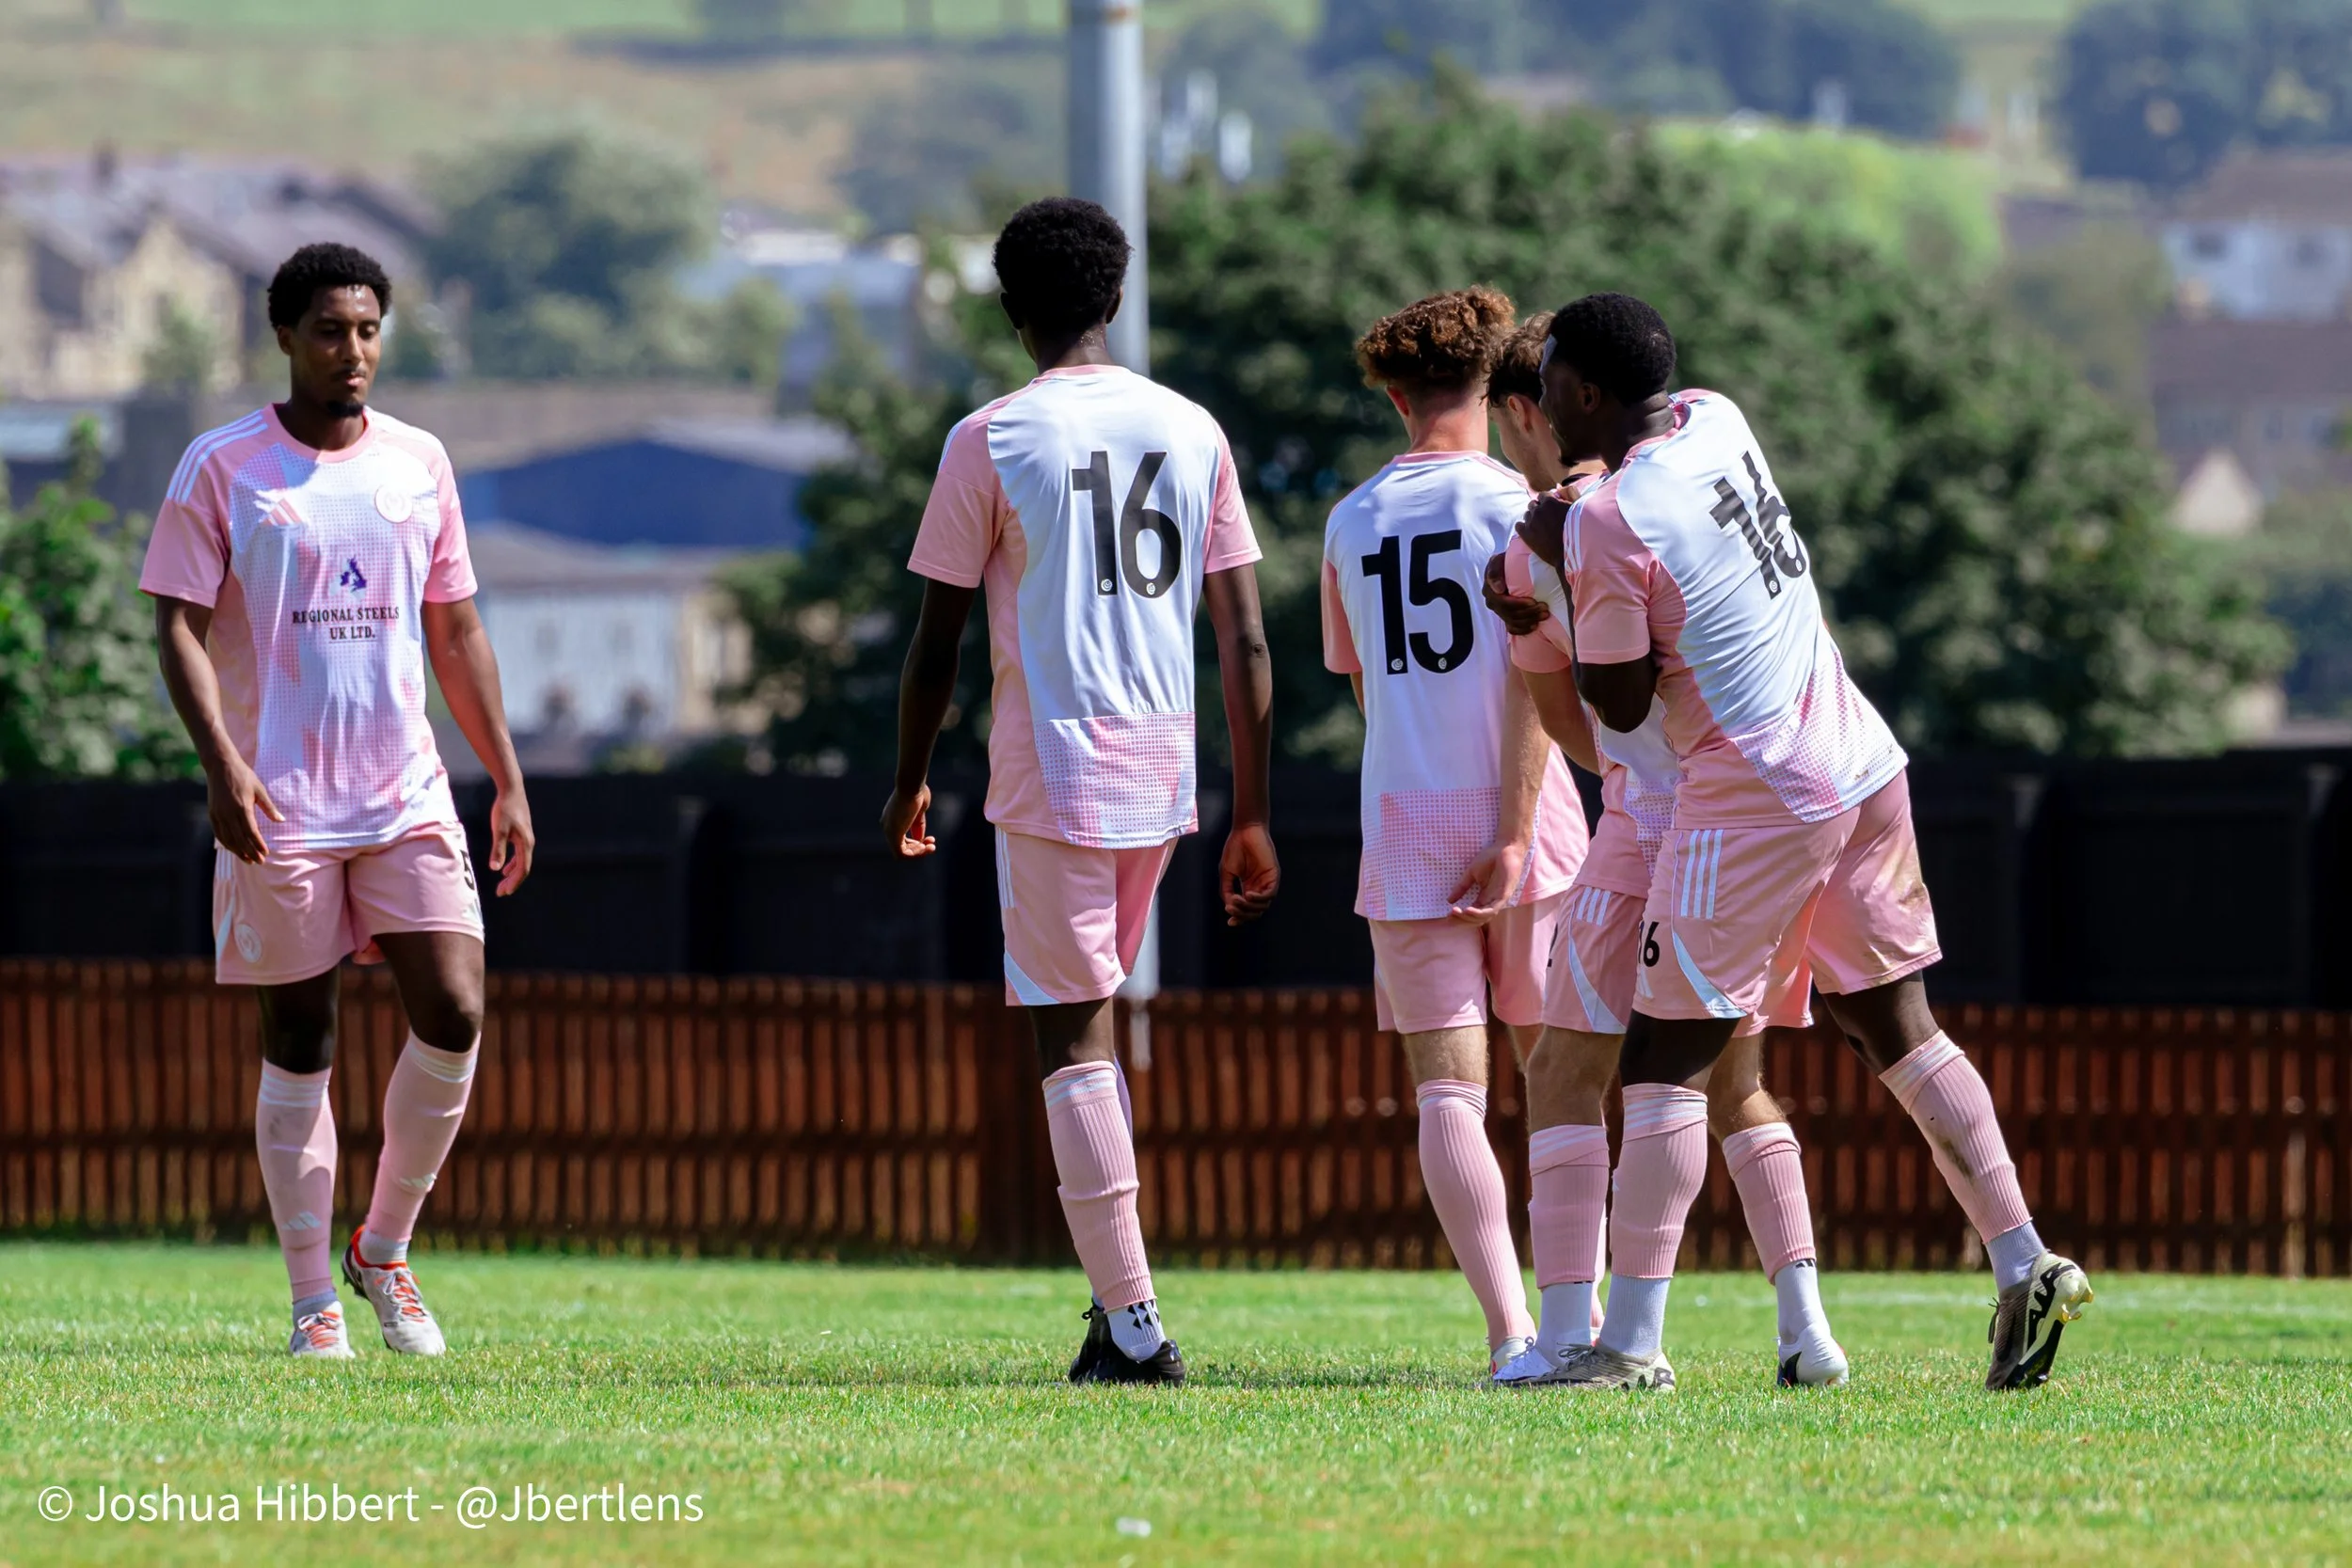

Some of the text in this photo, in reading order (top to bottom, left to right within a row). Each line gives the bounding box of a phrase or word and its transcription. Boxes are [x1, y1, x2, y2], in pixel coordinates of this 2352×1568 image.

[1071, 451, 1182, 599] 16
[1708, 451, 1807, 600] 16
[292, 607, 400, 624] REGIONAL STEELS
[329, 626, 376, 640] UK LTD.
[1360, 529, 1474, 675] 15
